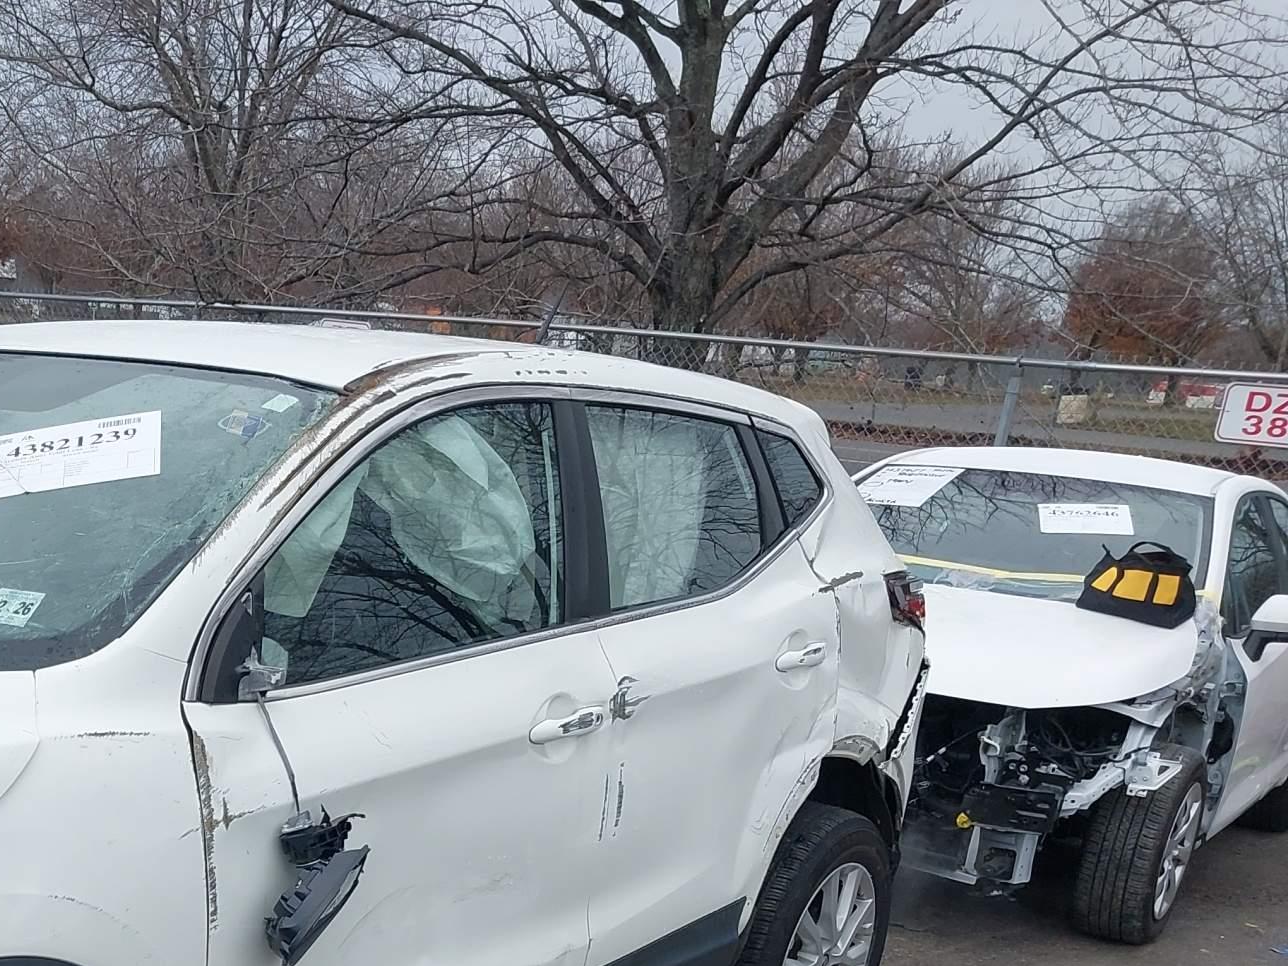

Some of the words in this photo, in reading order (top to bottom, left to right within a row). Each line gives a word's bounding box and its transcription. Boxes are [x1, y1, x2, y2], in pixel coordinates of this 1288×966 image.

[1242, 415, 1288, 438] 38
[6, 427, 138, 458] 43821239
[12, 601, 34, 616] 26
